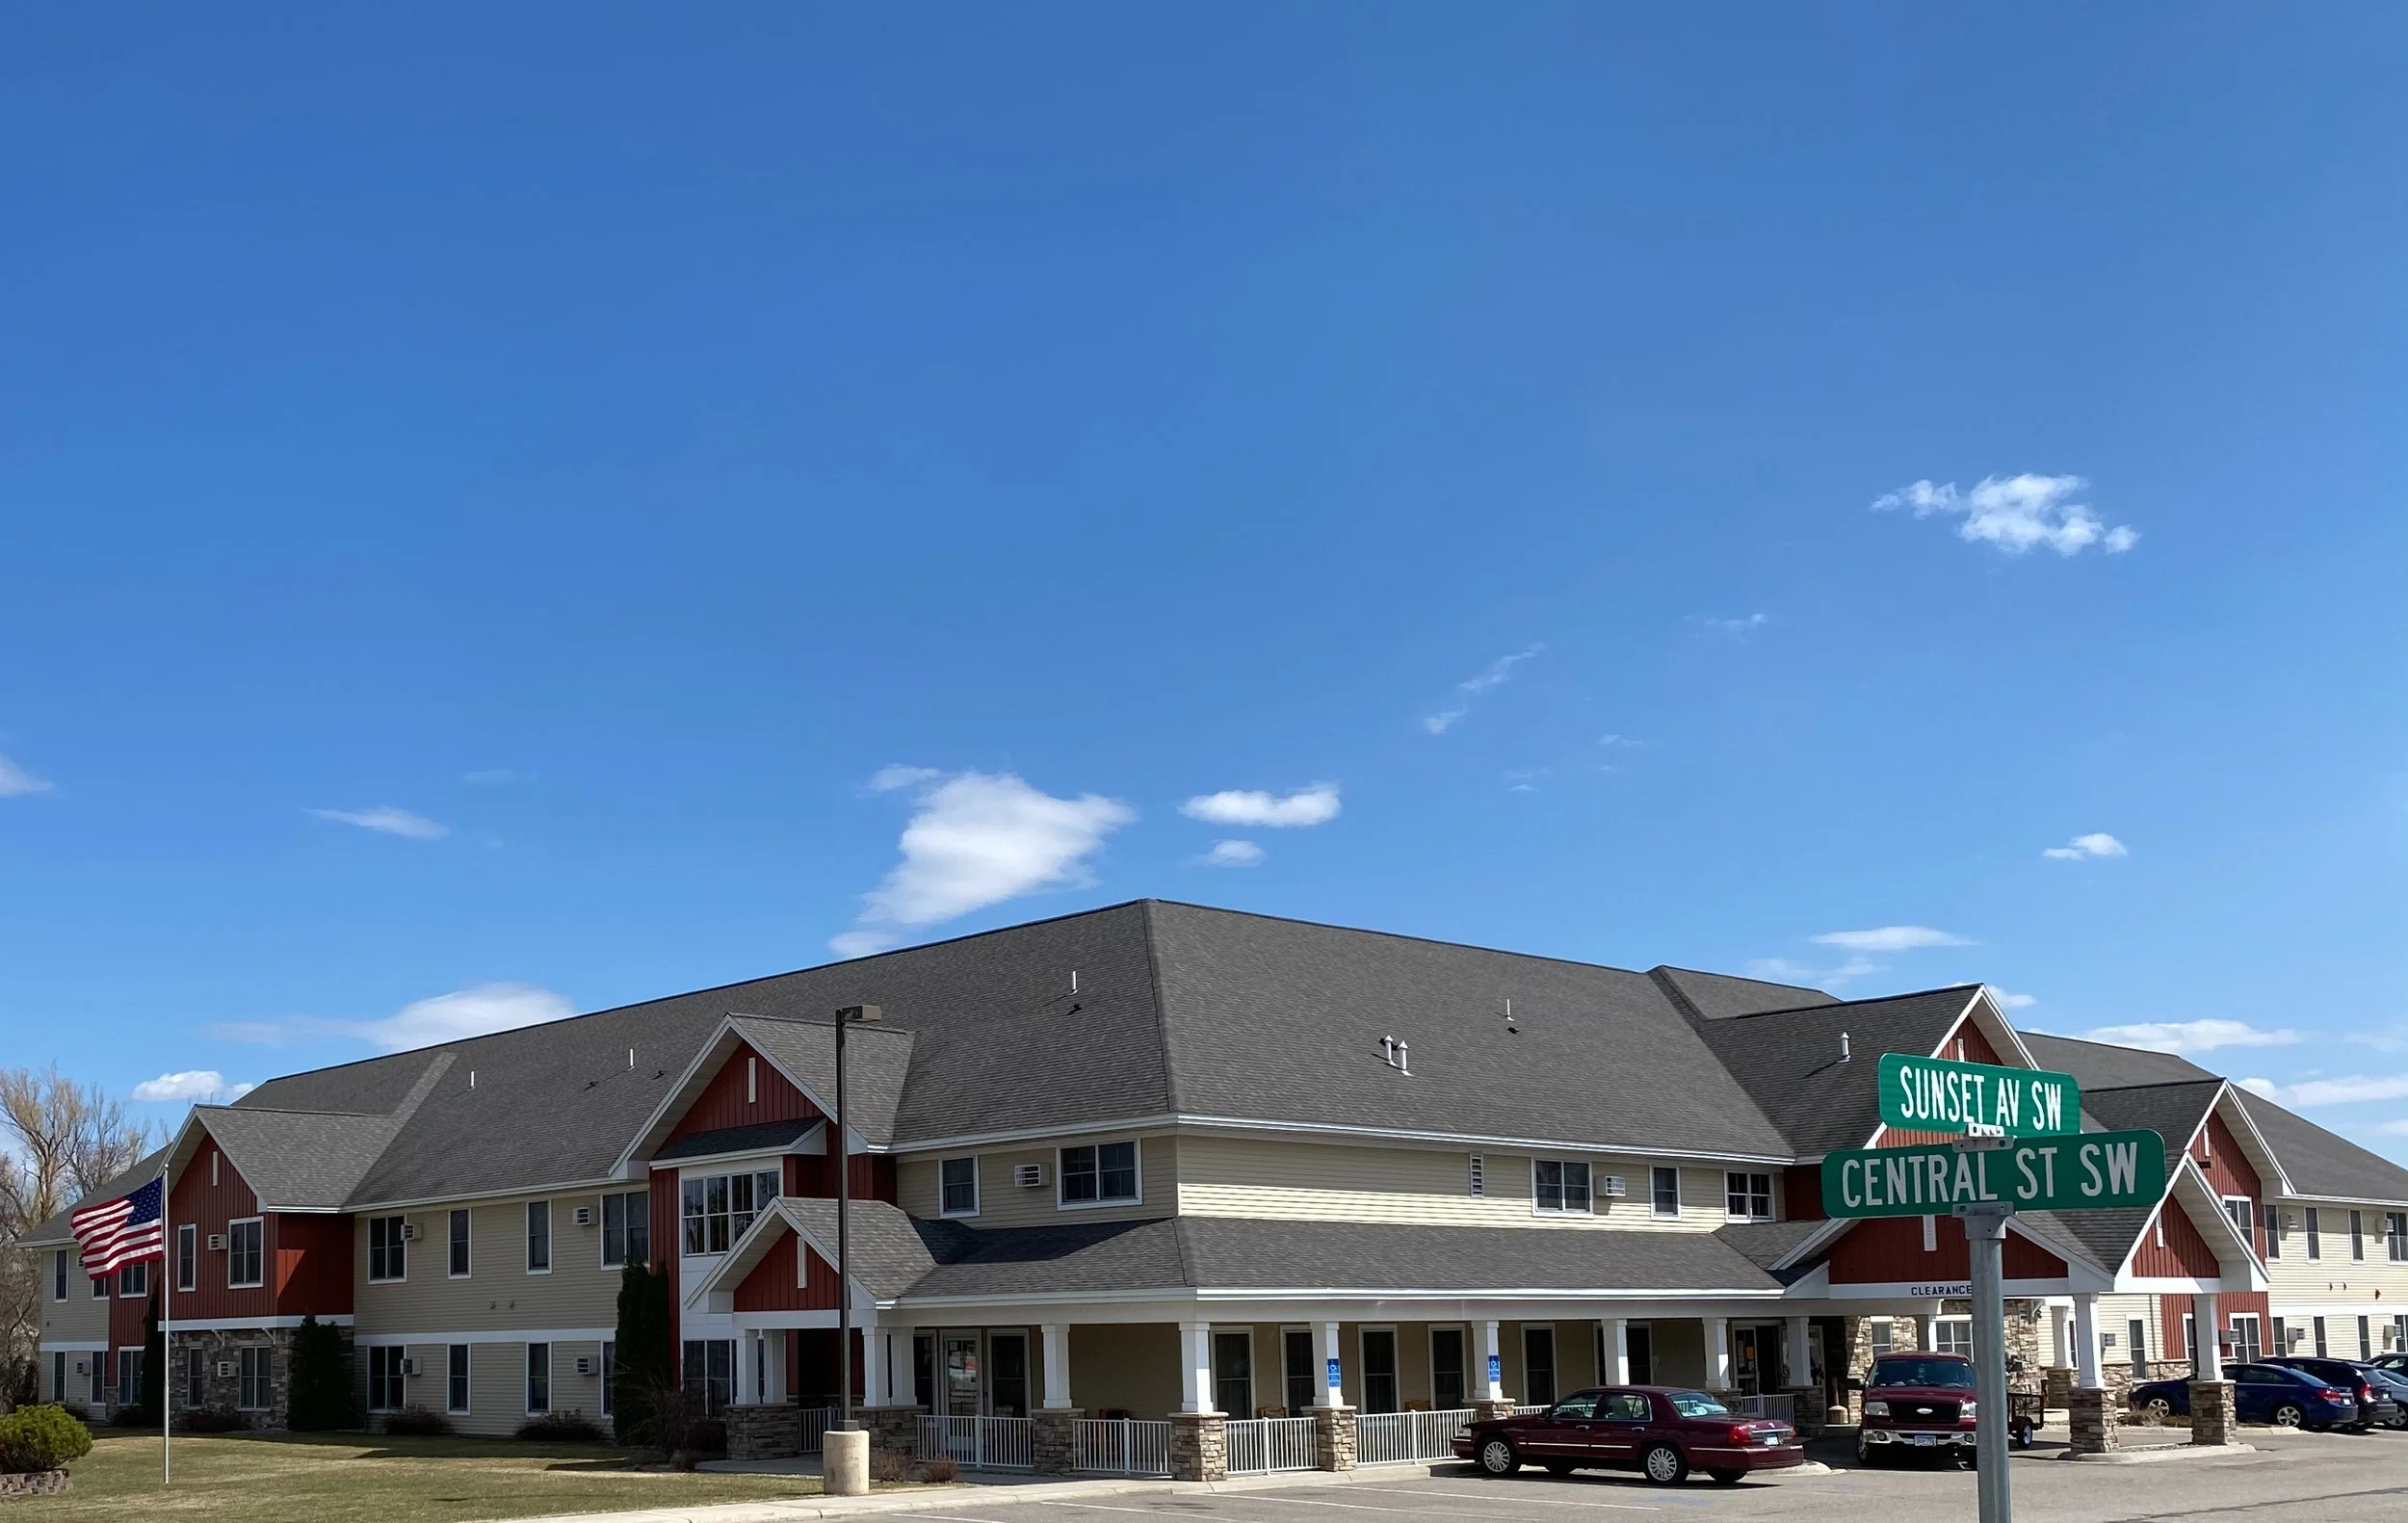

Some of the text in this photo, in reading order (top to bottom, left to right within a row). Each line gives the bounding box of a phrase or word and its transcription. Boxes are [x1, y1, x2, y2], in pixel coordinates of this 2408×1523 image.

[1899, 1065, 2062, 1132] SUNSET AV SW
[1842, 1142, 2138, 1208] CENTRAL ST SW
[1911, 1285, 1973, 1296] CLEARANCE
